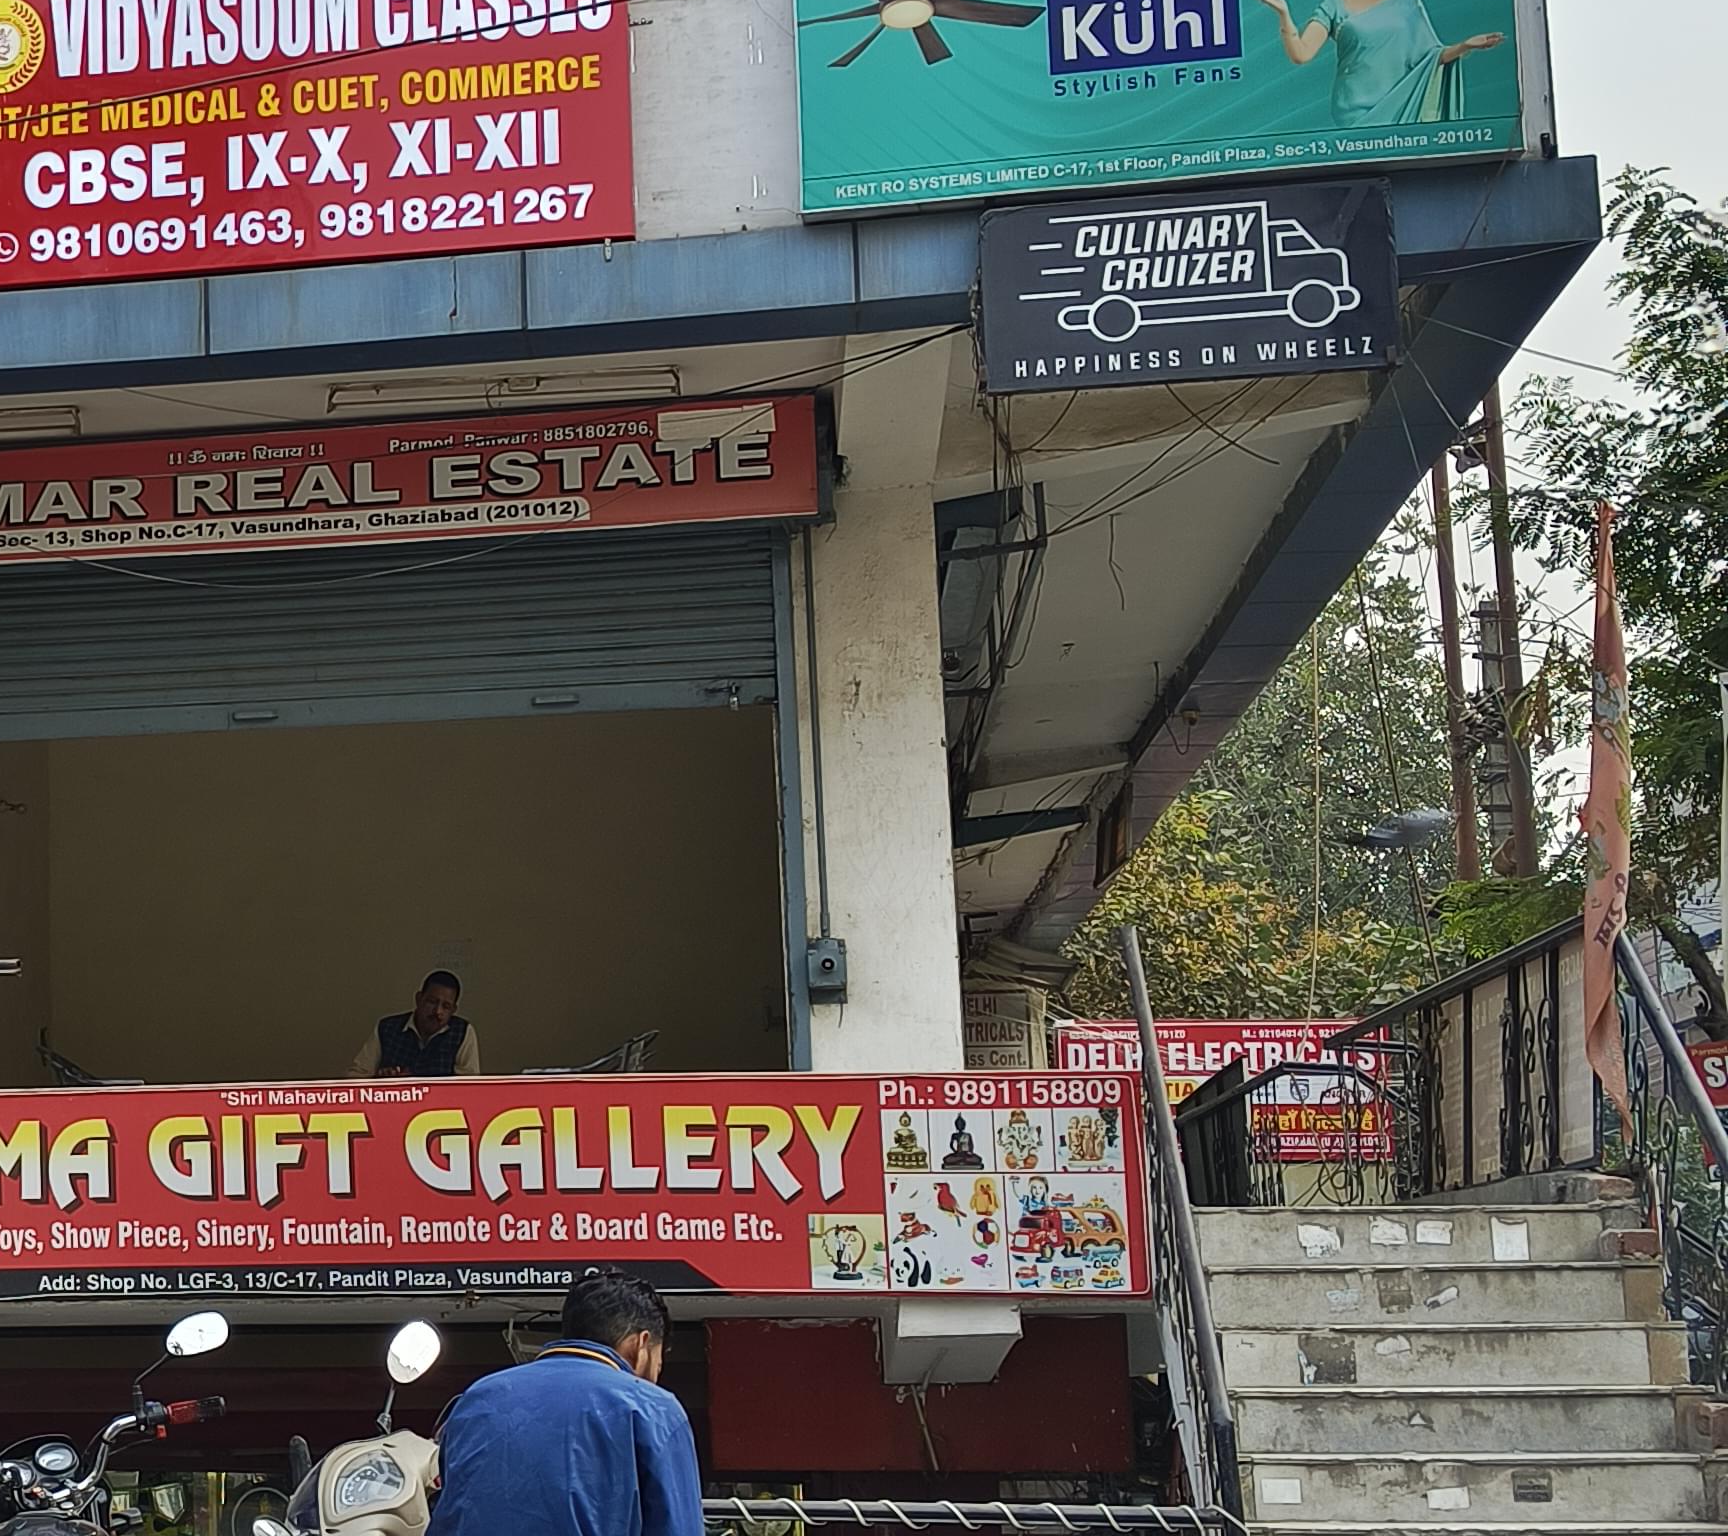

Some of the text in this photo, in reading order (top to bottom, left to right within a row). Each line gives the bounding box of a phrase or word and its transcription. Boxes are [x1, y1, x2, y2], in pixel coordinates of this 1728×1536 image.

[99, 81, 246, 131] MEDICAL
[292, 74, 388, 114] CUET,
[400, 55, 602, 106] COMMERCE
[1053, 62, 1242, 98] Stylish Fans
[23, 107, 560, 210] CBSE, IX-X, XI-XII
[835, 131, 1429, 201] KENT RO SYSTEMS LIMITED Pandit Vasundhara
[29, 184, 594, 264] 9810691463, 9818221267
[1075, 210, 1258, 260] CULINARY
[1102, 250, 1256, 293] CRUIZER
[1014, 335, 1374, 379] HAPPINESS ON WHEELZ
[176, 461, 401, 516] REAL
[432, 428, 774, 501] ESTATE
[81, 527, 132, 546] Shop
[231, 514, 361, 537] Vasundhara,
[367, 506, 480, 528] Ghaziabad
[989, 1050, 1026, 1066] Cont.
[943, 1079, 1121, 1106] 9891158809
[148, 1110, 374, 1209] GIFT
[404, 1103, 864, 1203] GALLERY
[50, 1222, 110, 1251] Show
[117, 1221, 190, 1251] Piece,
[196, 1219, 277, 1251] Sinery,
[282, 1216, 393, 1249] Fountain,
[400, 1214, 491, 1244] Remote
[498, 1215, 543, 1242] Car
[576, 1213, 650, 1242] Board
[656, 1213, 727, 1242] Game
[733, 1213, 783, 1242] Etc.
[86, 1266, 572, 1294] Shop Pandit Plaza, Vasundhara
